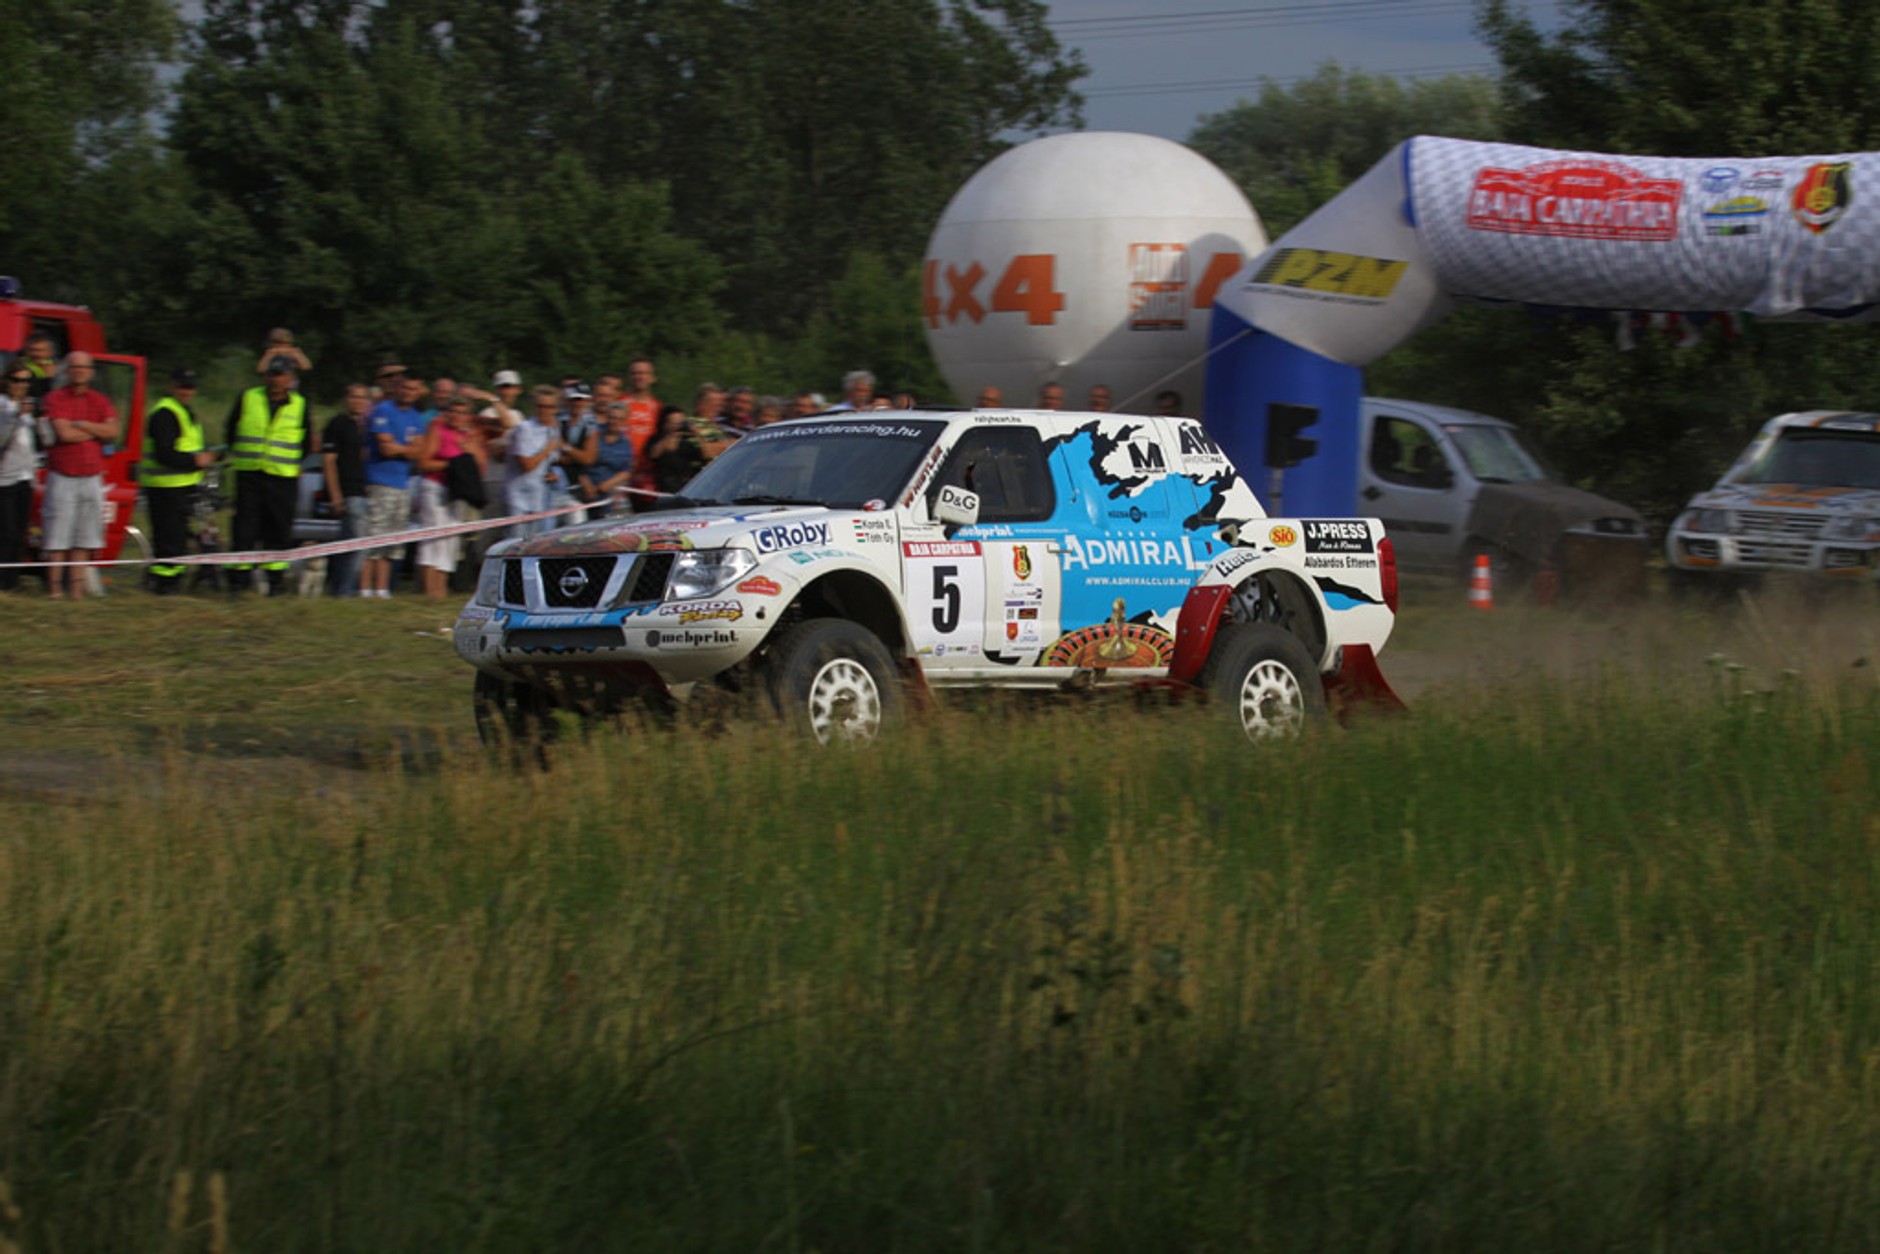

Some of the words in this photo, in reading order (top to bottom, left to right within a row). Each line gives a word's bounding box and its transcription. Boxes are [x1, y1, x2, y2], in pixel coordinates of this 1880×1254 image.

[747, 423, 922, 443] www.kordaracing.hu
[941, 489, 976, 510] D&G
[1307, 522, 1368, 540] J.PRESS
[1063, 534, 1211, 571] ADMIRAL
[659, 601, 742, 616] KORDA
[932, 566, 961, 633] 5
